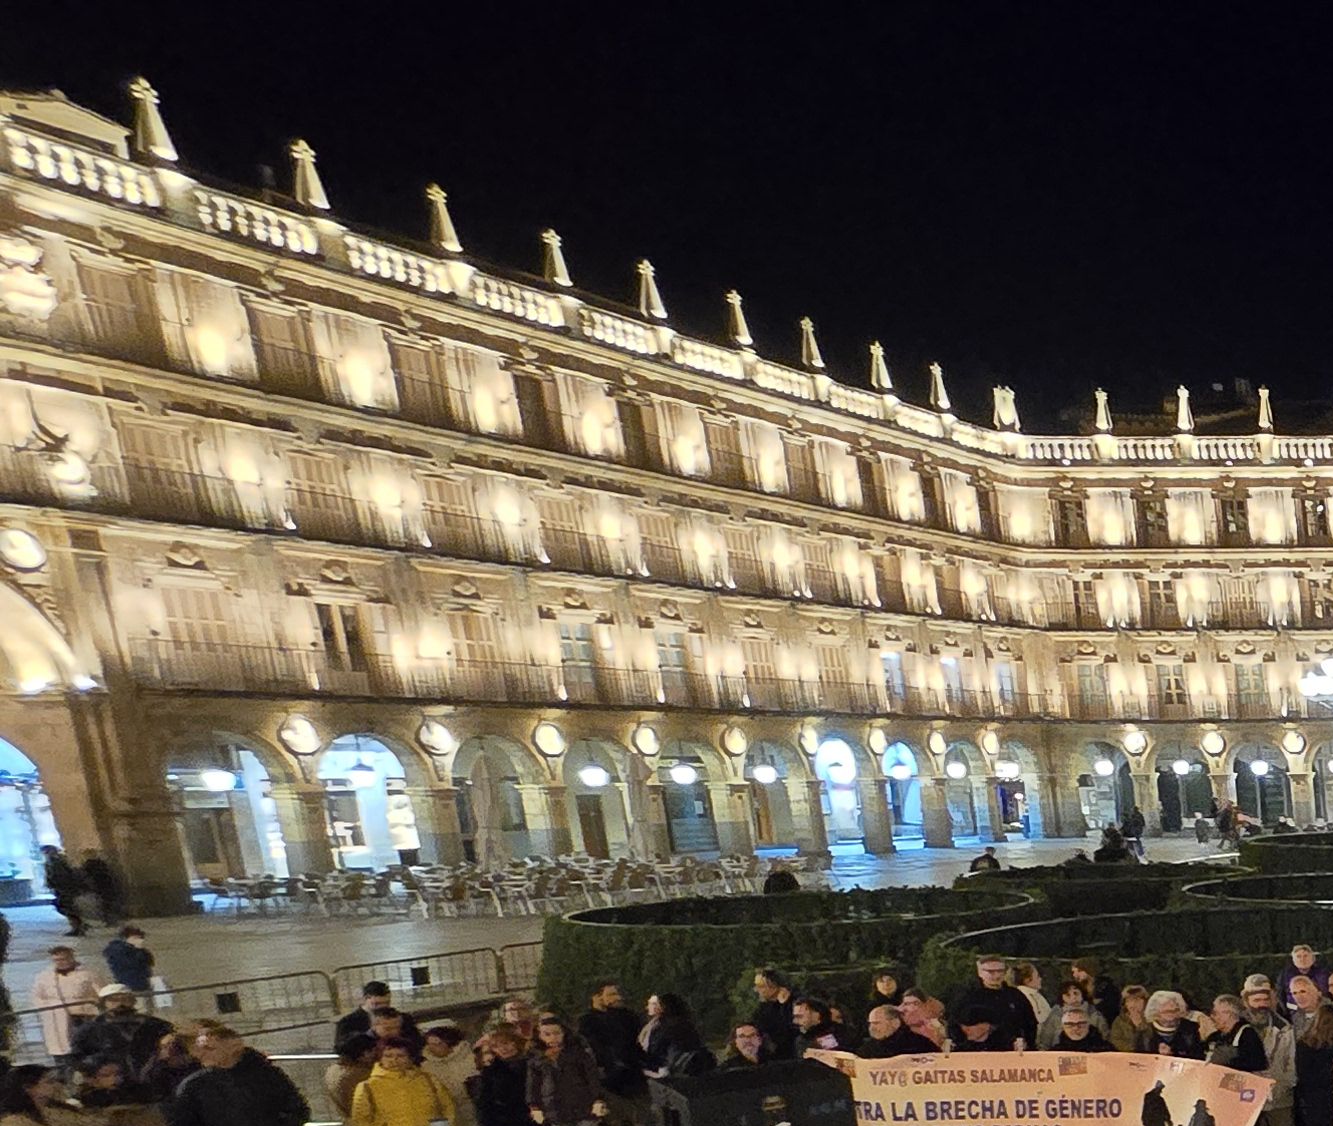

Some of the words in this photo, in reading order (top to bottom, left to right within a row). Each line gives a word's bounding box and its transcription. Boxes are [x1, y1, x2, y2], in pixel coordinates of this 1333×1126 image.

[912, 1070, 966, 1084] GAITAS
[970, 1066, 1054, 1083] SALAMANCA
[892, 1100, 917, 1122] LA
[924, 1100, 1007, 1120] BRECHA
[1014, 1098, 1038, 1119] DE
[1044, 1093, 1122, 1119] GÉNERO
